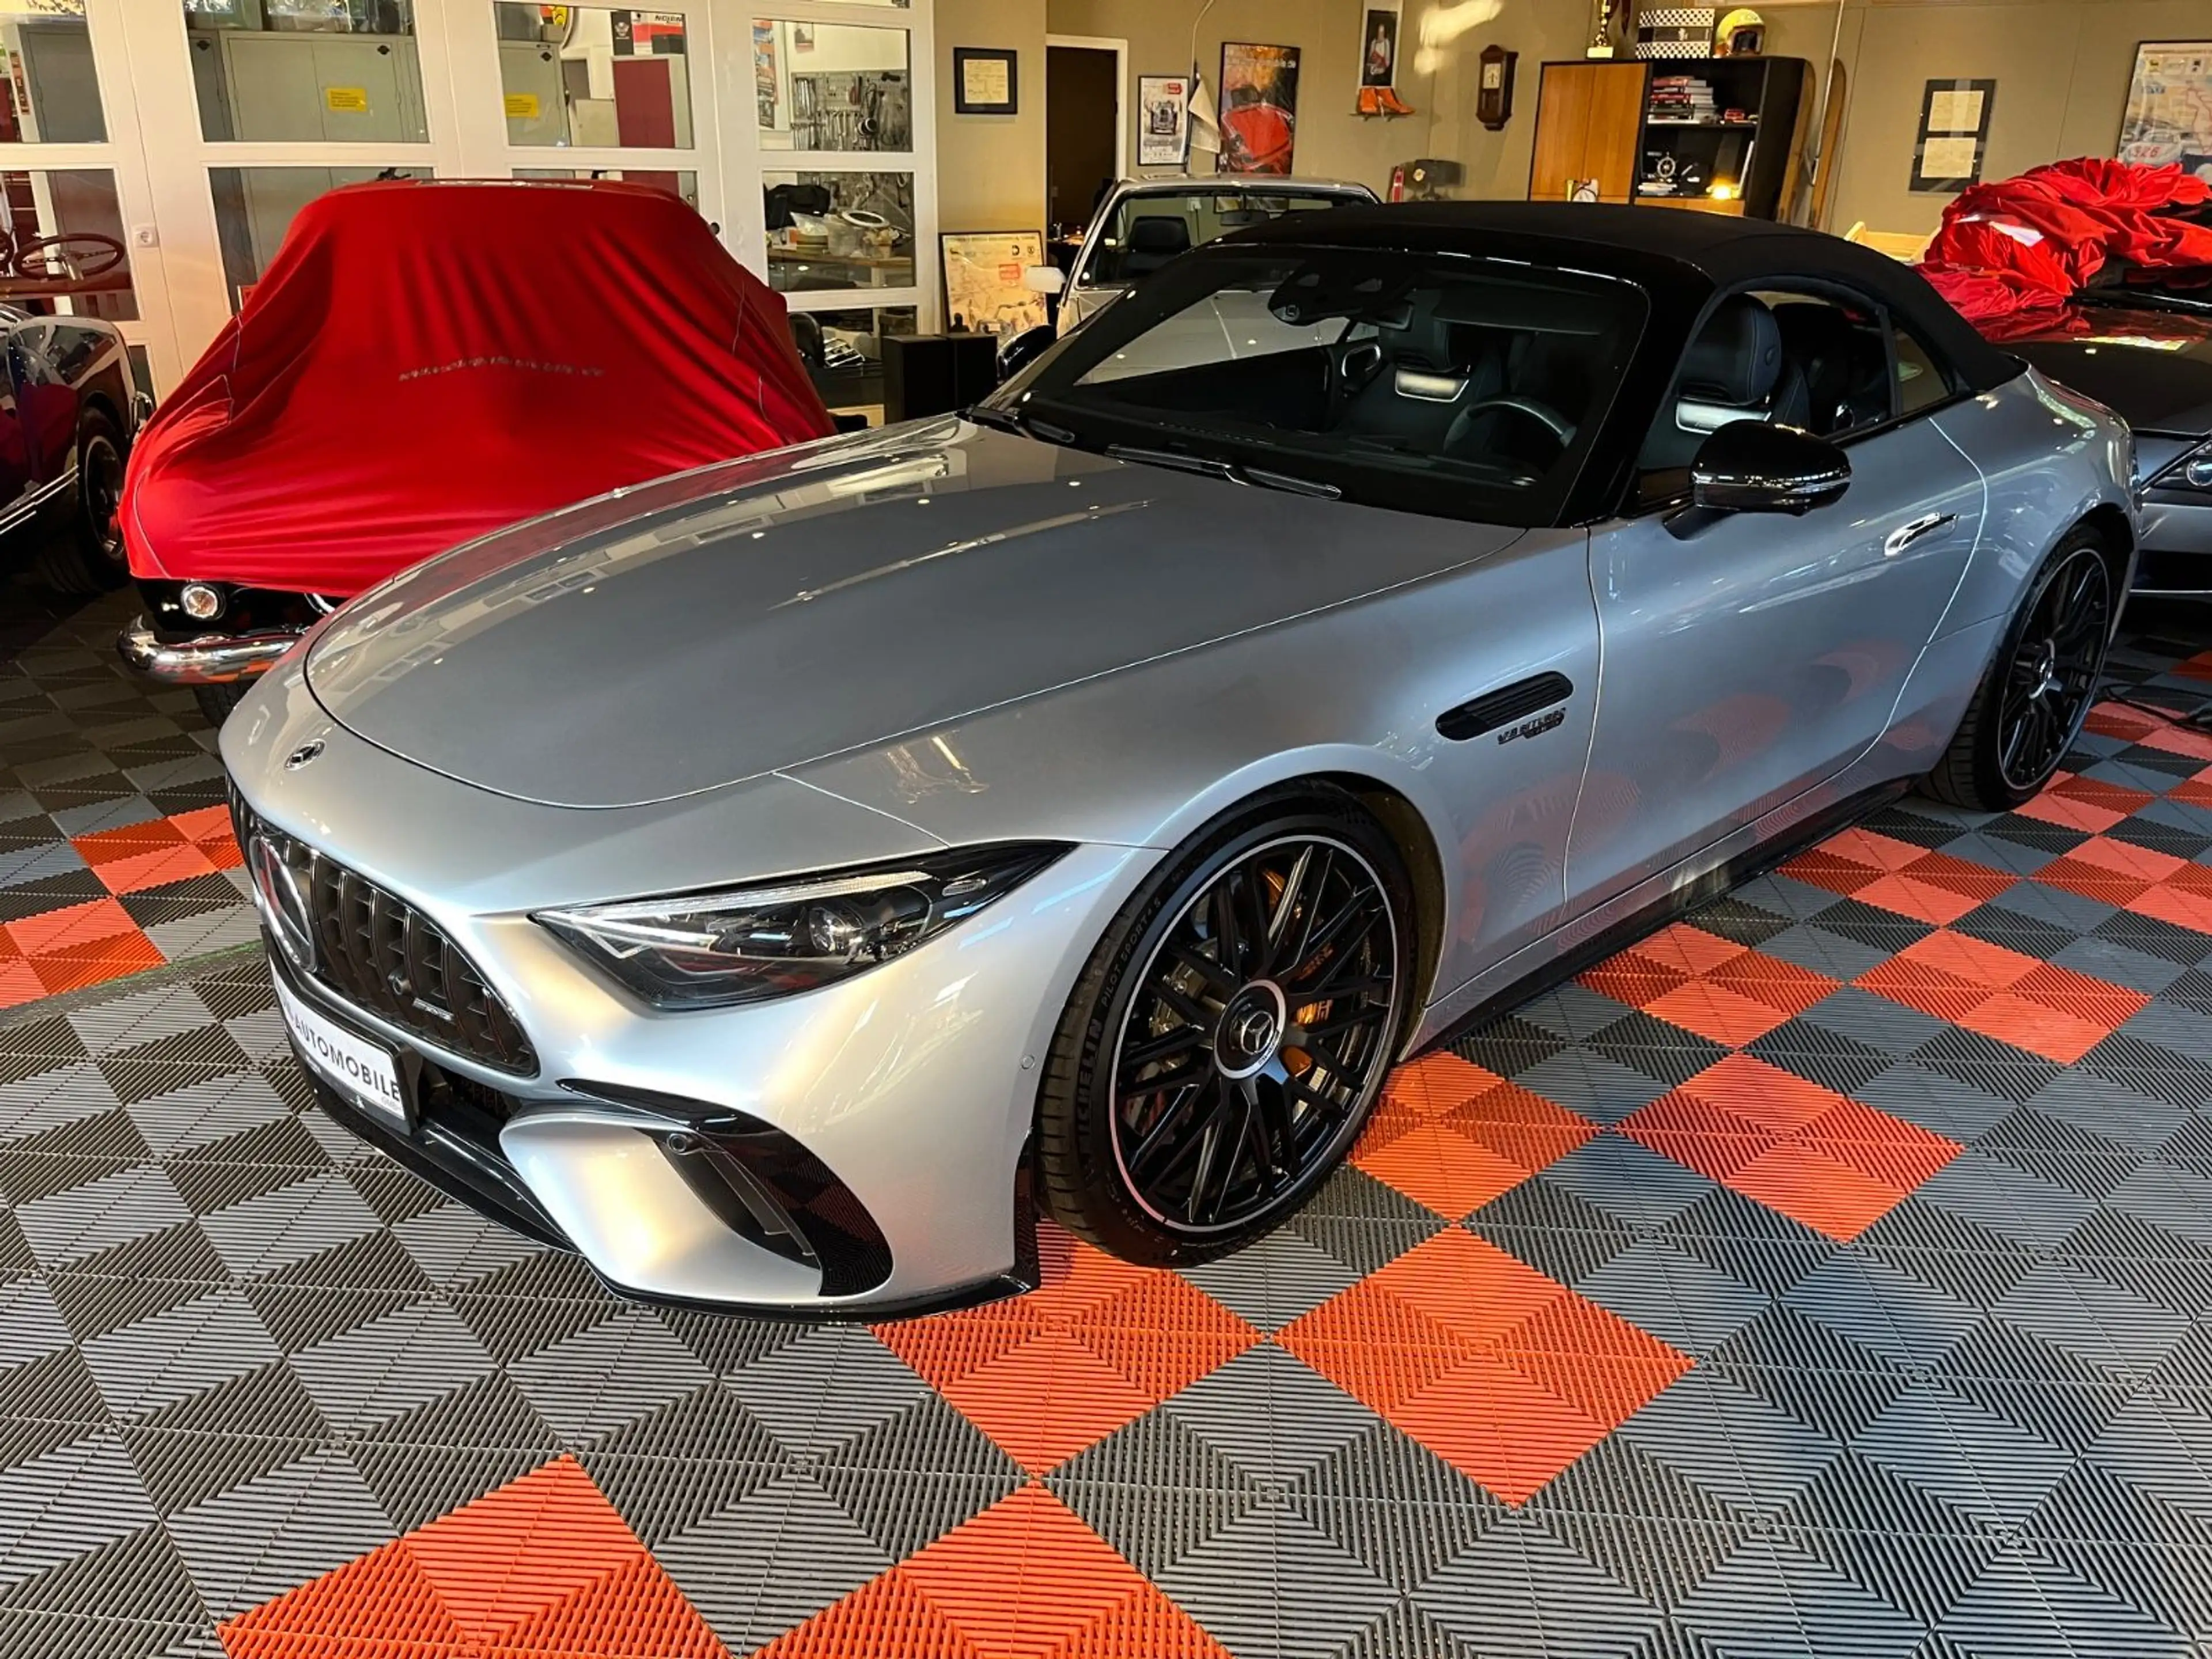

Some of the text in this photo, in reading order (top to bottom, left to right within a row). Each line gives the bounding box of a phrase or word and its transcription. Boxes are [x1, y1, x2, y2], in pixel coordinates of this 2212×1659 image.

[1100, 963, 1122, 1007] PILOT
[1120, 916, 1149, 961] SPORT
[294, 1013, 400, 1103] AUTOMOBILE
[1076, 1017, 1103, 1155] ICHELIN
